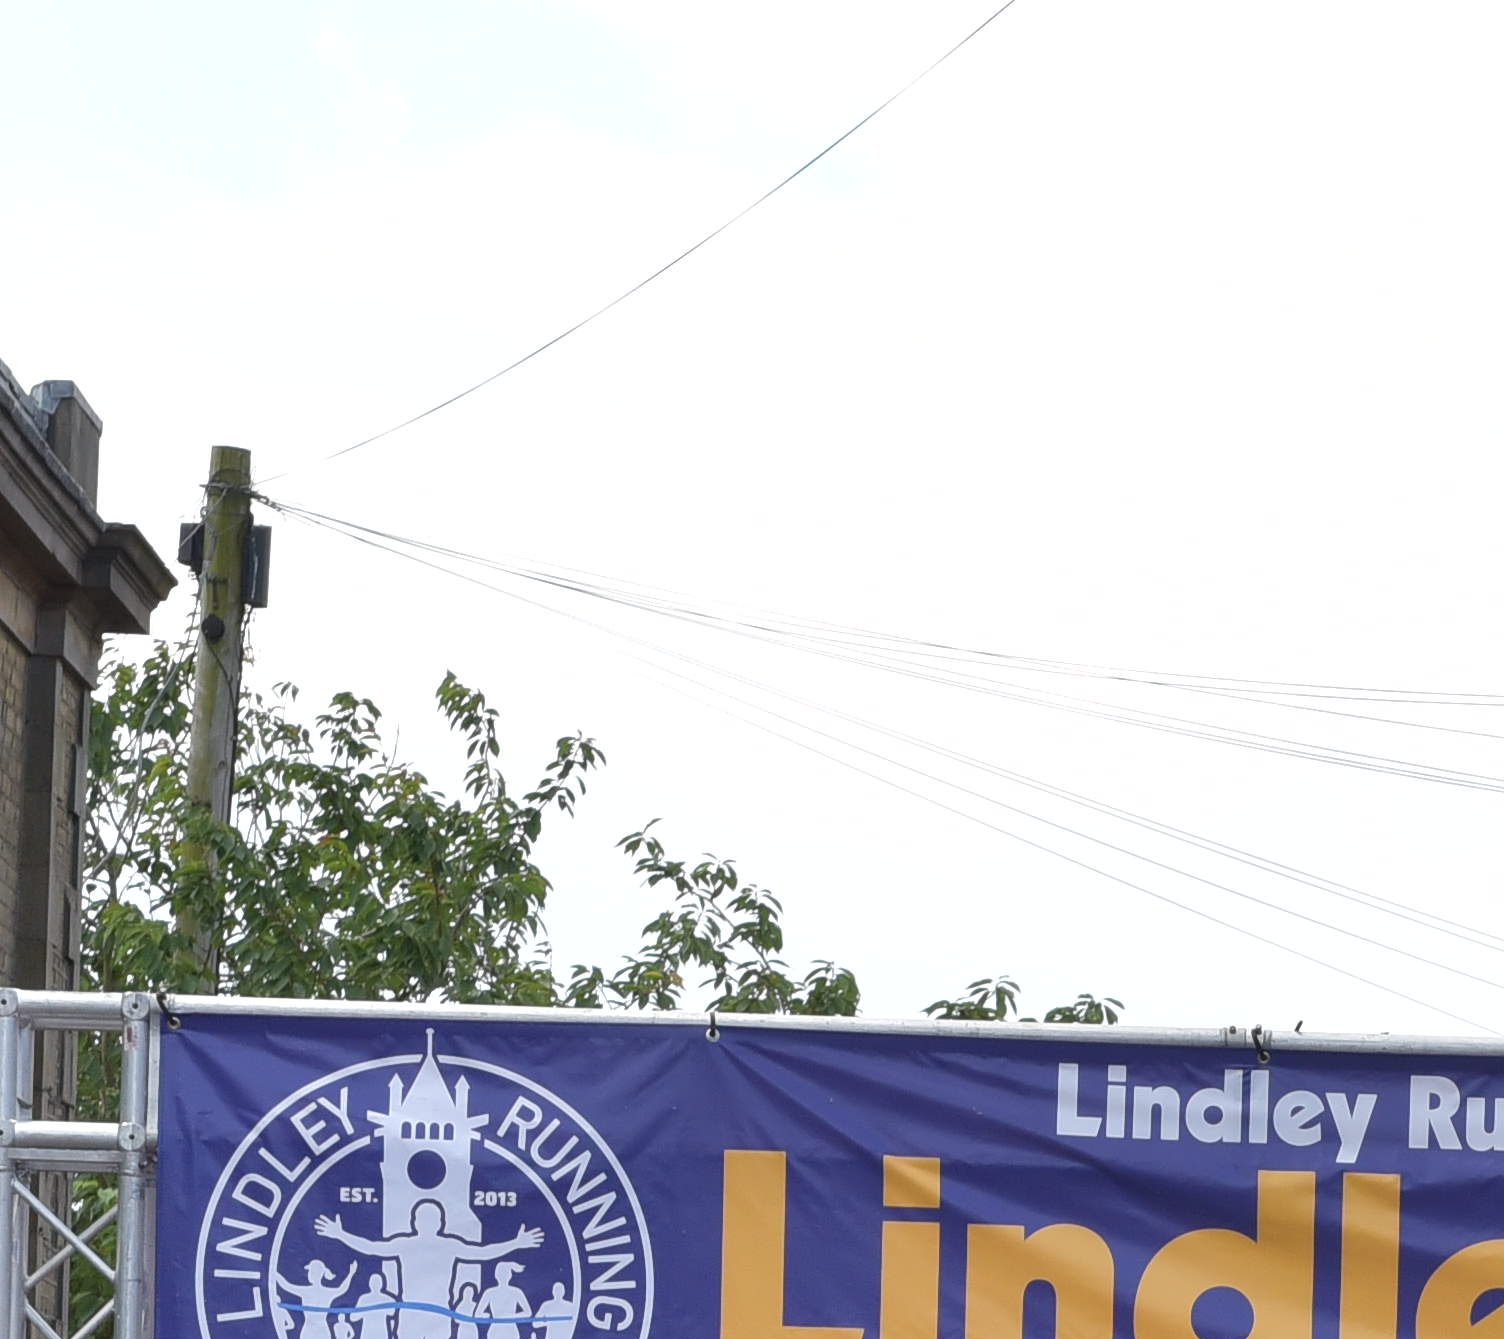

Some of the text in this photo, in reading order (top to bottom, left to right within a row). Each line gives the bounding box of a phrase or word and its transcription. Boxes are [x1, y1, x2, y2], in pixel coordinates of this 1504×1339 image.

[1055, 1061, 1378, 1164] Lindley
[214, 1086, 637, 1332] LINDLEY RUNNING
[339, 1187, 378, 1204] EST.
[474, 1189, 517, 1208] 2013
